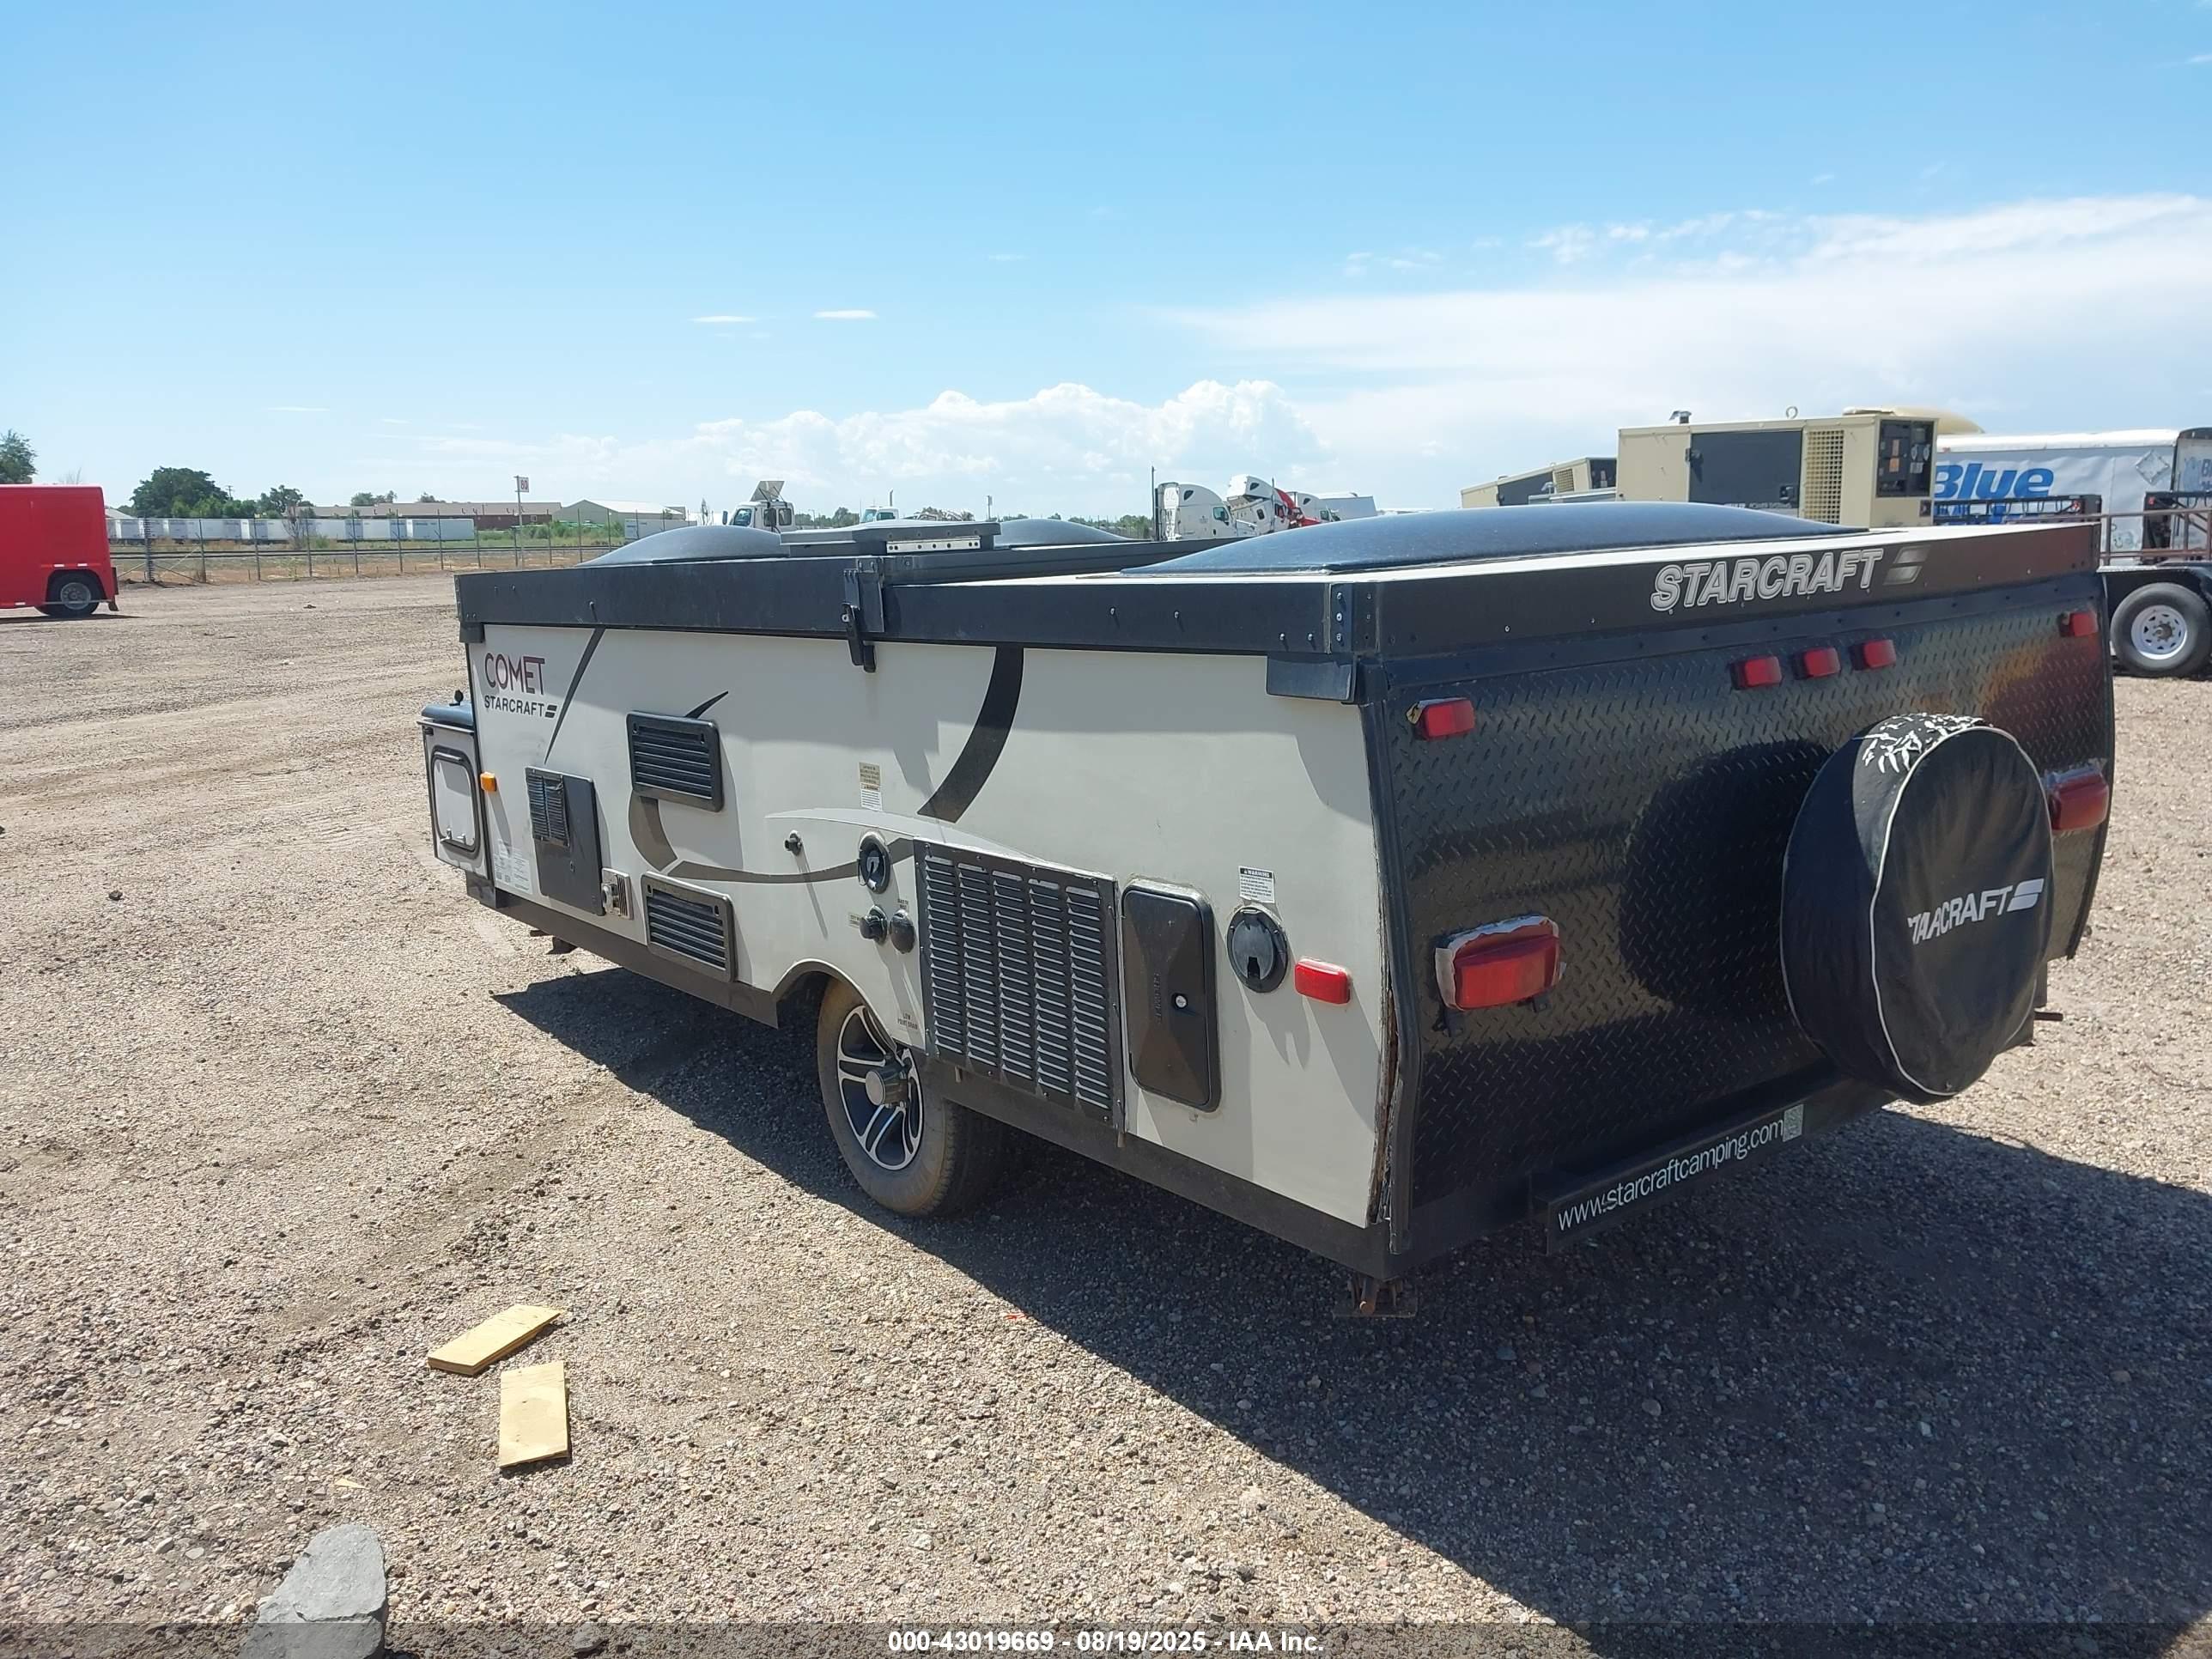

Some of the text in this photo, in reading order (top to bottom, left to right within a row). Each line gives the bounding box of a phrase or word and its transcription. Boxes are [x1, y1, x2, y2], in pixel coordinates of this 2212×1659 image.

[520, 479, 528, 490] 80
[1934, 463, 2054, 498] Blue
[1650, 549, 1884, 611] STARCRAFT
[484, 653, 545, 696] COMET
[484, 695, 544, 717] STARCRAFT
[1558, 1118, 1784, 1231] www.starcraftcamping.com
